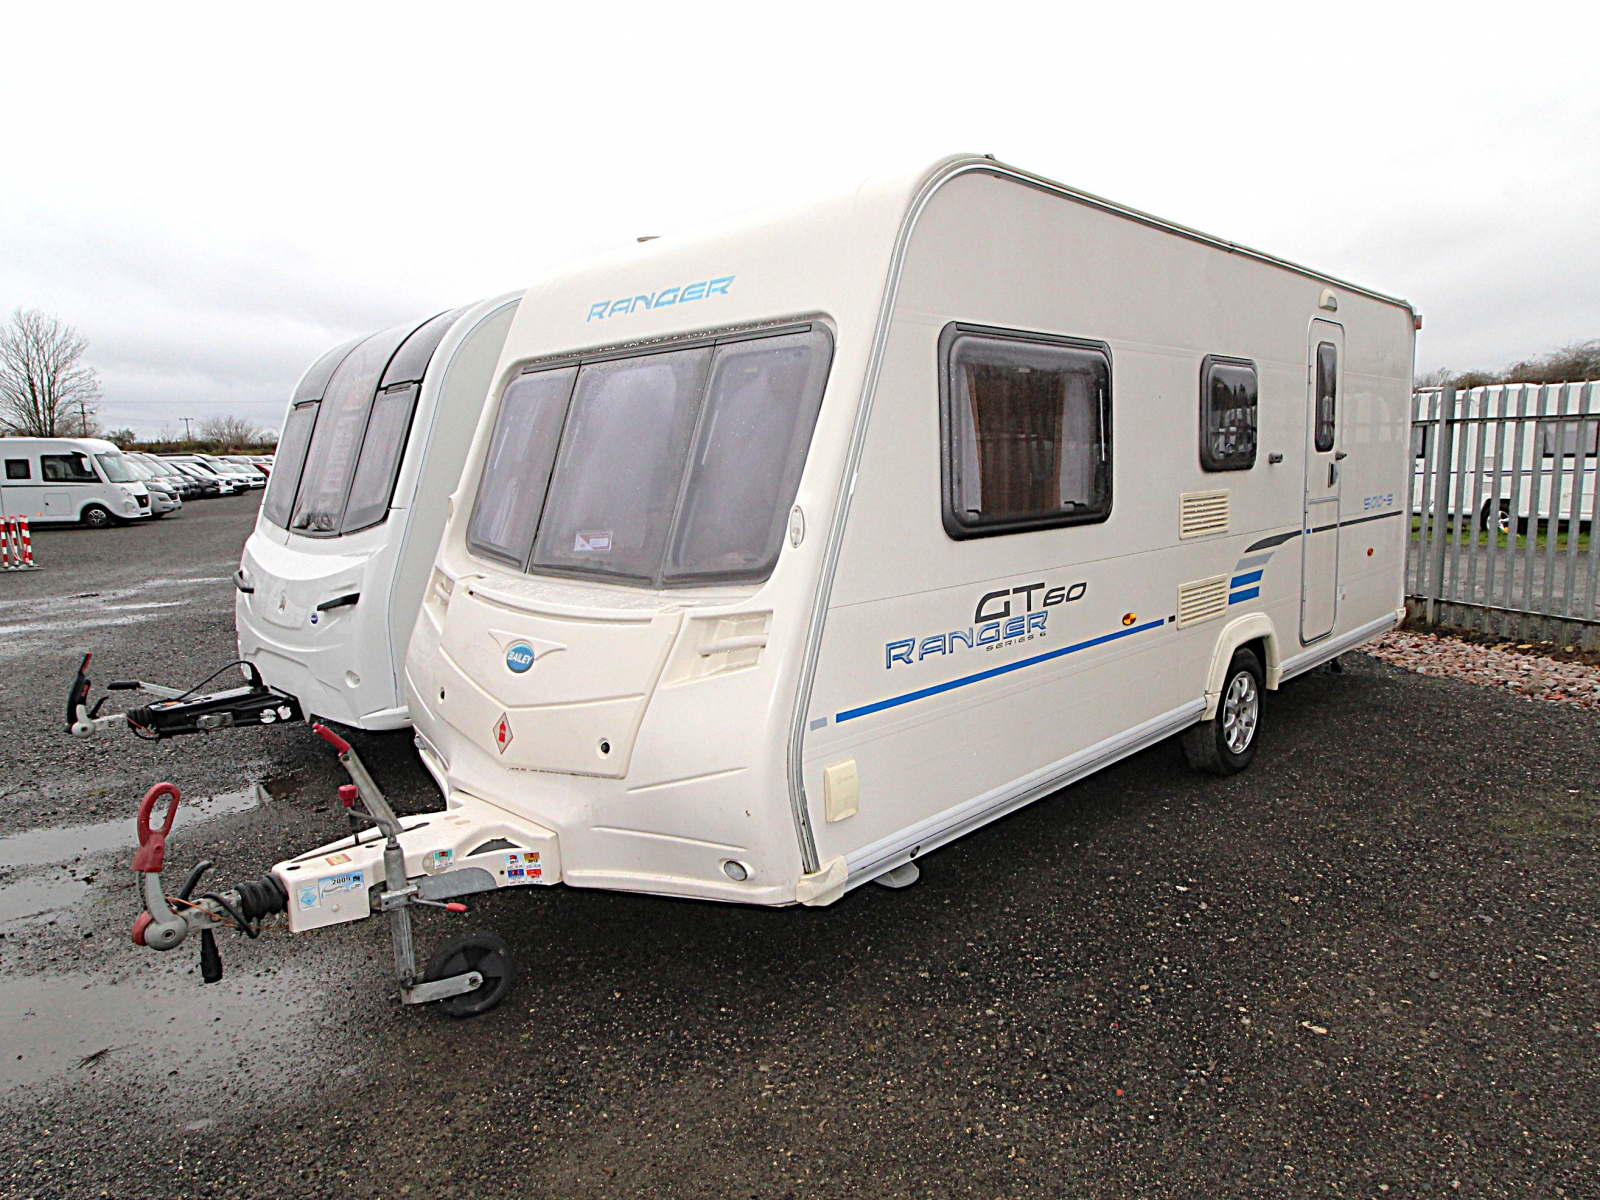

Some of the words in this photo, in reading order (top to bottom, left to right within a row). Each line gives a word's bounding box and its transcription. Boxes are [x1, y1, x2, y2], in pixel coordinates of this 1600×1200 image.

[586, 275, 735, 322] RANGER
[885, 610, 1049, 669] RANGER
[985, 633, 1035, 652] SERIES
[507, 651, 533, 665] BAILEY
[331, 876, 351, 885] 2009
